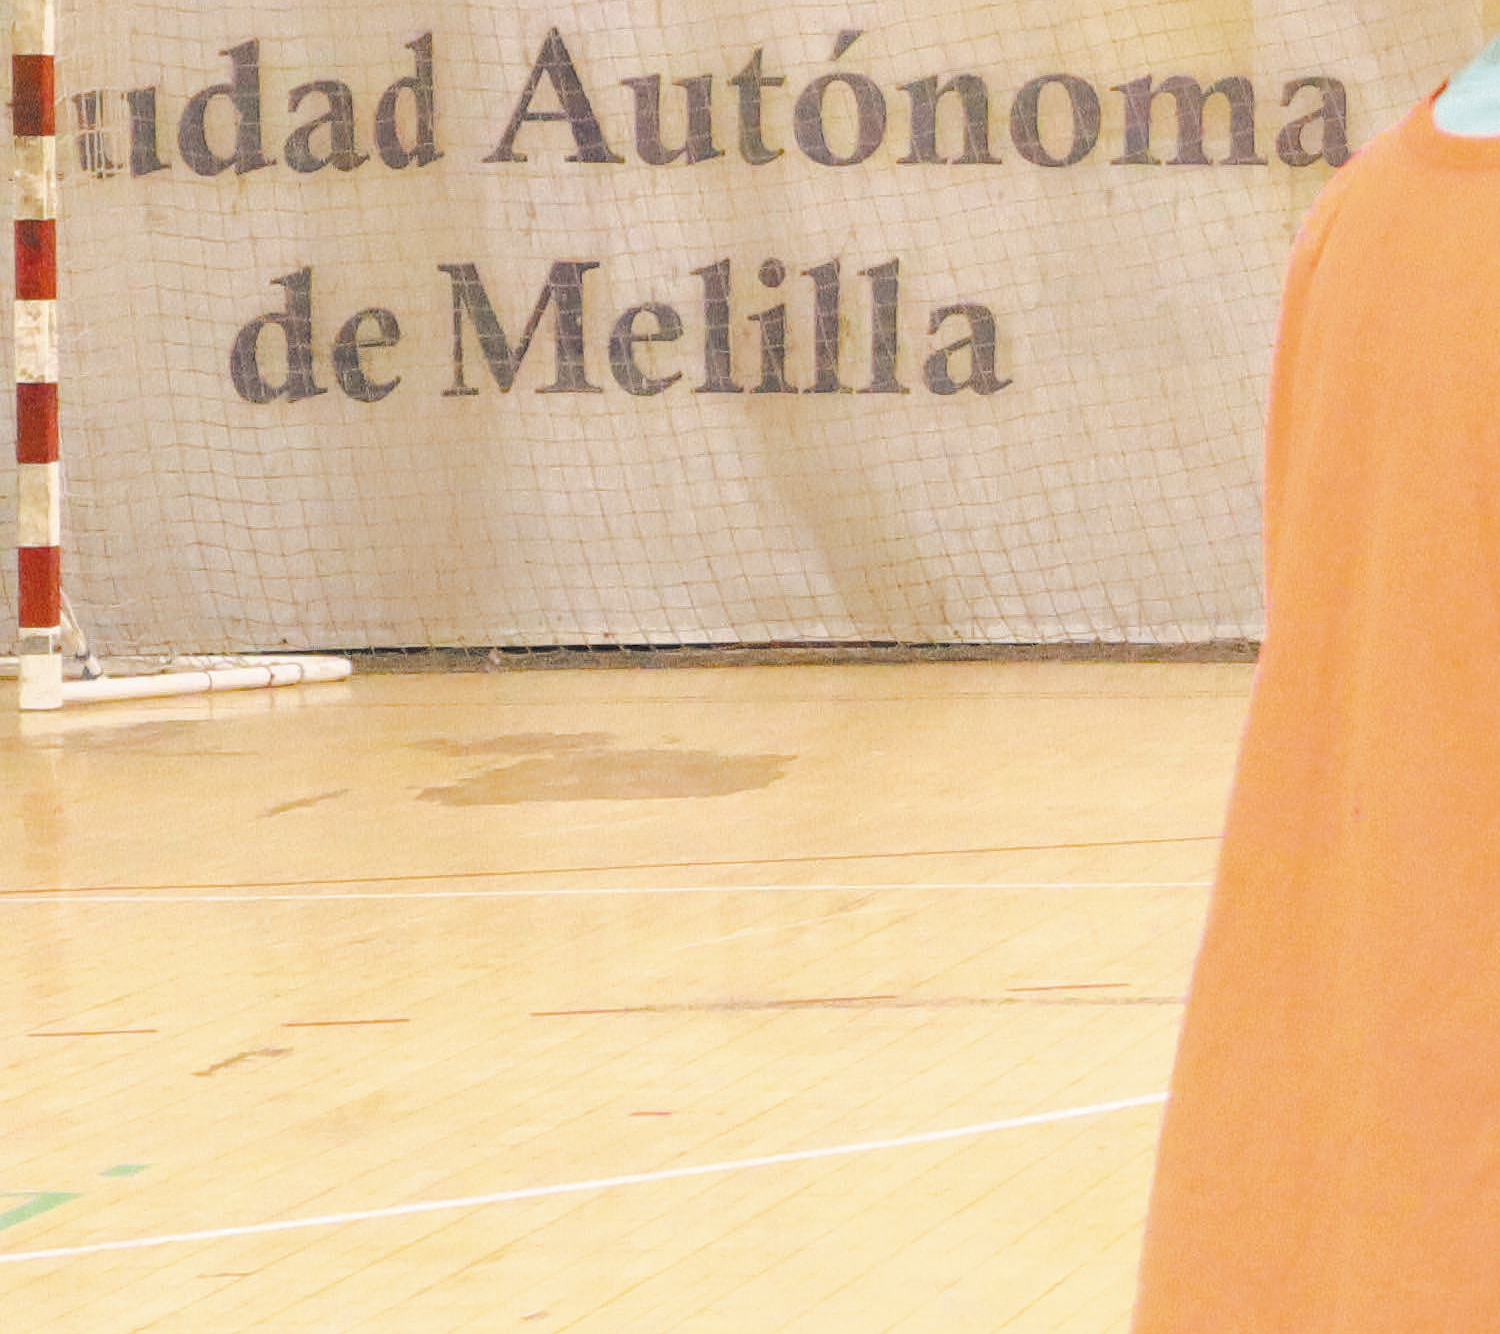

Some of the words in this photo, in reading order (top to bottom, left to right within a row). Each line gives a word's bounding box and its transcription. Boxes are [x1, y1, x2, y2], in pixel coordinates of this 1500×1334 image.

[481, 27, 1353, 168] Autónoma
[230, 266, 402, 404] de
[437, 259, 1013, 397] Melilla
